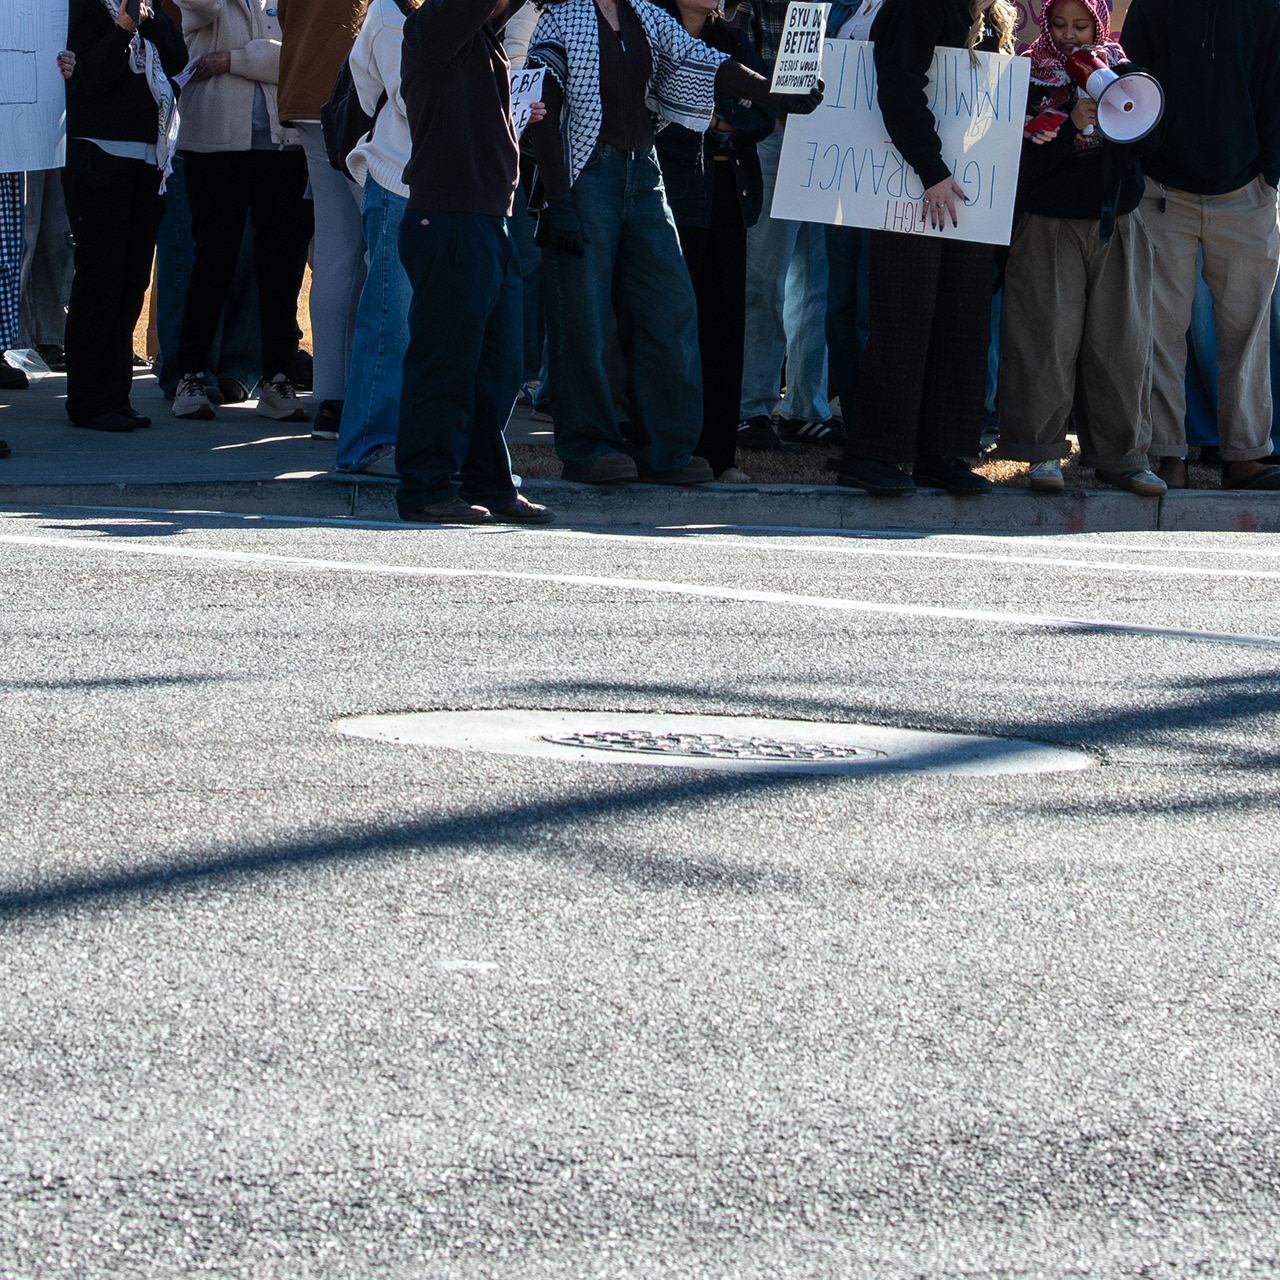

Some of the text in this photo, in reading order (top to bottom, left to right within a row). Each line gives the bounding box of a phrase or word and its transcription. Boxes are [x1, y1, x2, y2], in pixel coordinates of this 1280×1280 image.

[784, 30, 820, 54] BETTER
[780, 60, 818, 71] JESUS WOULD
[510, 71, 541, 95] CBP
